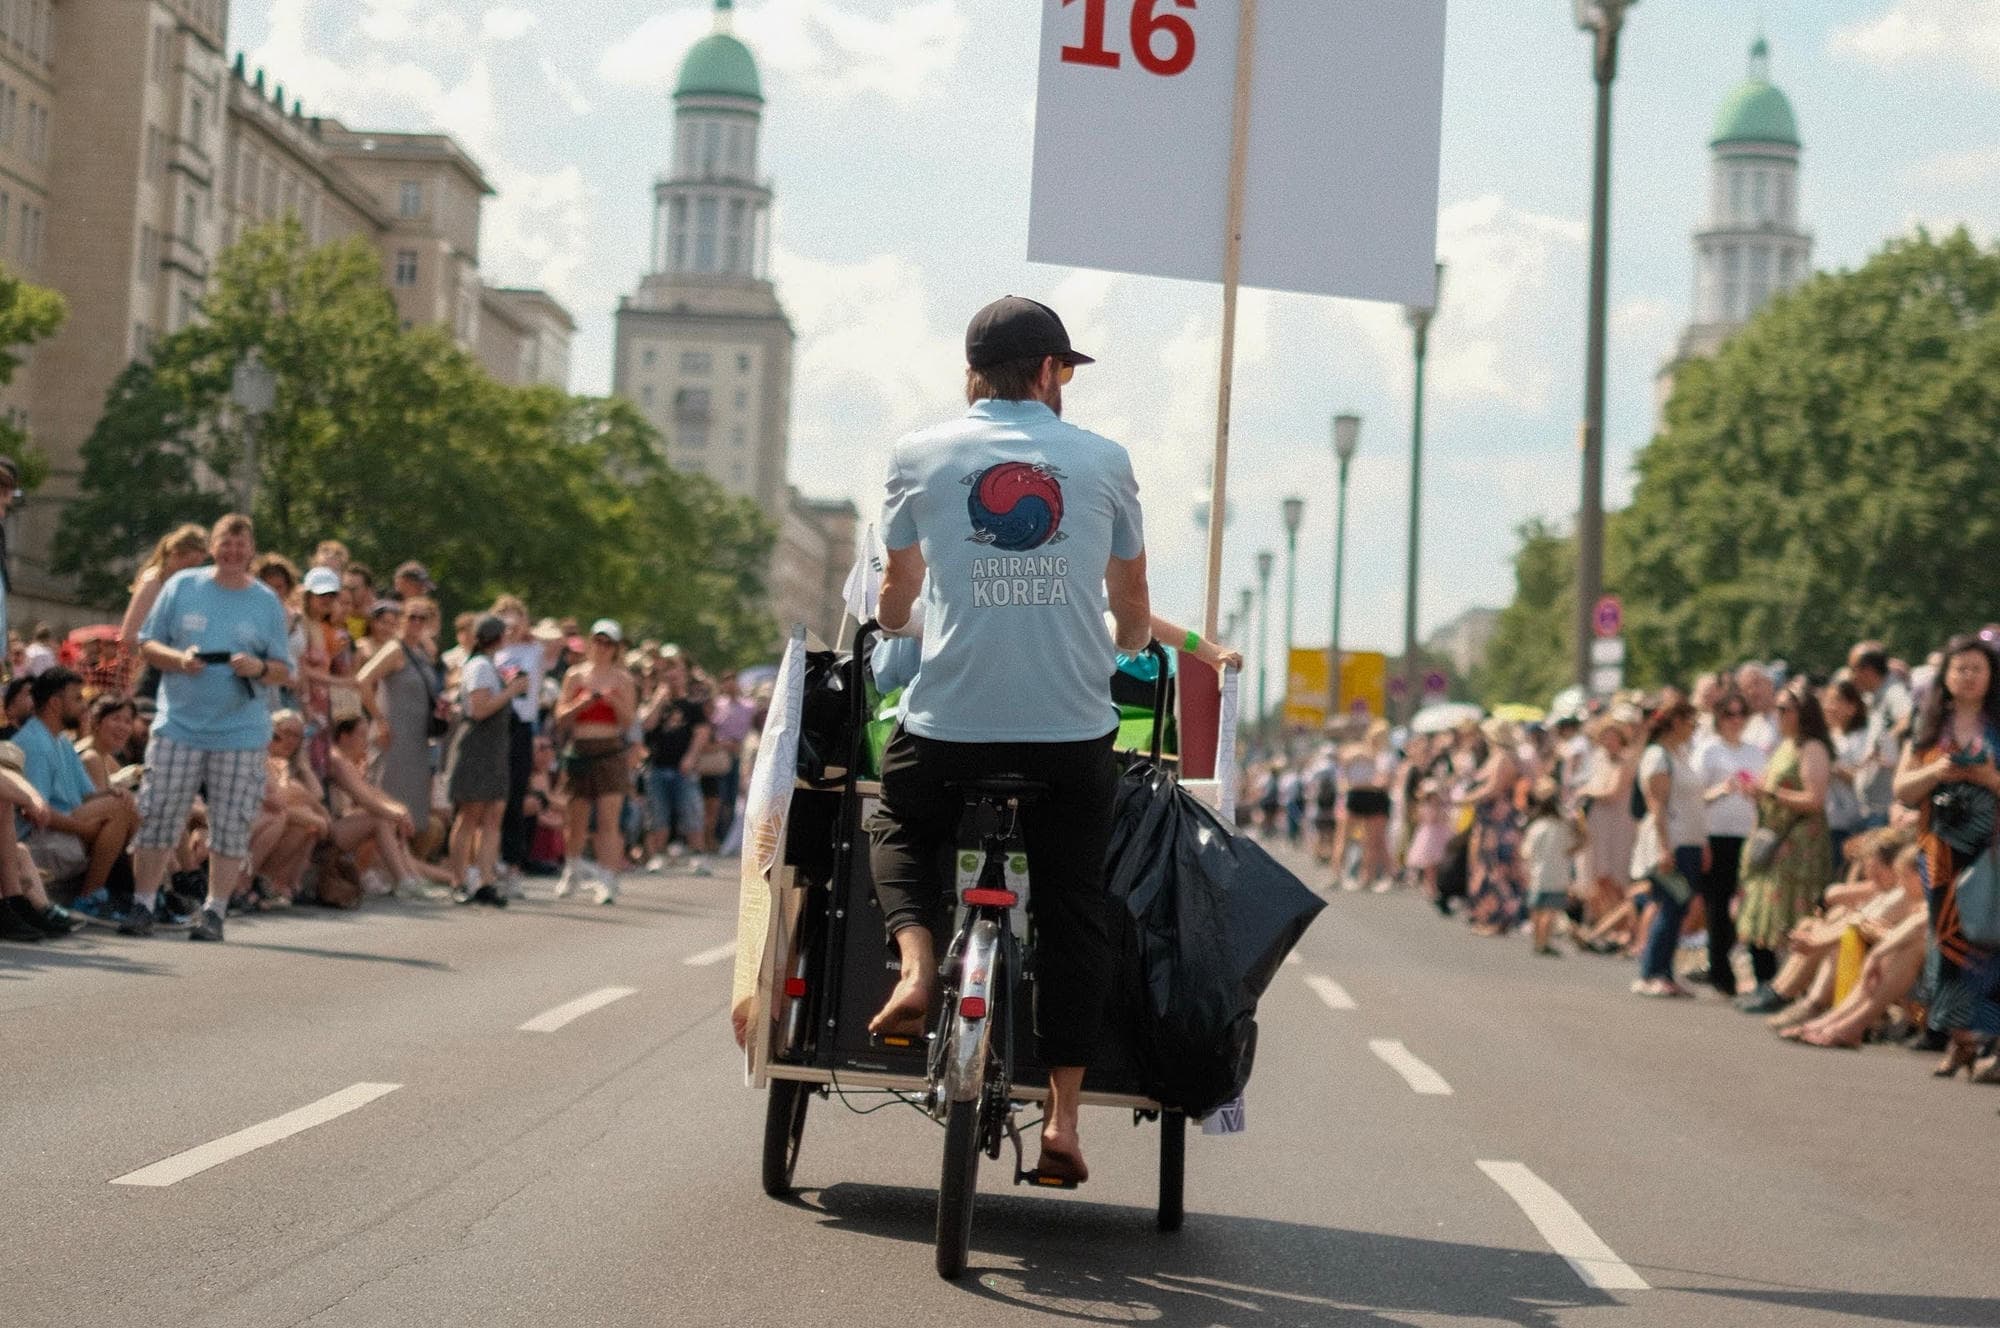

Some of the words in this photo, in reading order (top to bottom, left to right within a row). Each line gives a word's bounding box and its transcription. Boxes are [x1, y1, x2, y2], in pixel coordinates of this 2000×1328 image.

[1061, 0, 1197, 77] 16
[971, 556, 1068, 579] ARIRANG
[973, 578, 1068, 608] KOREA
